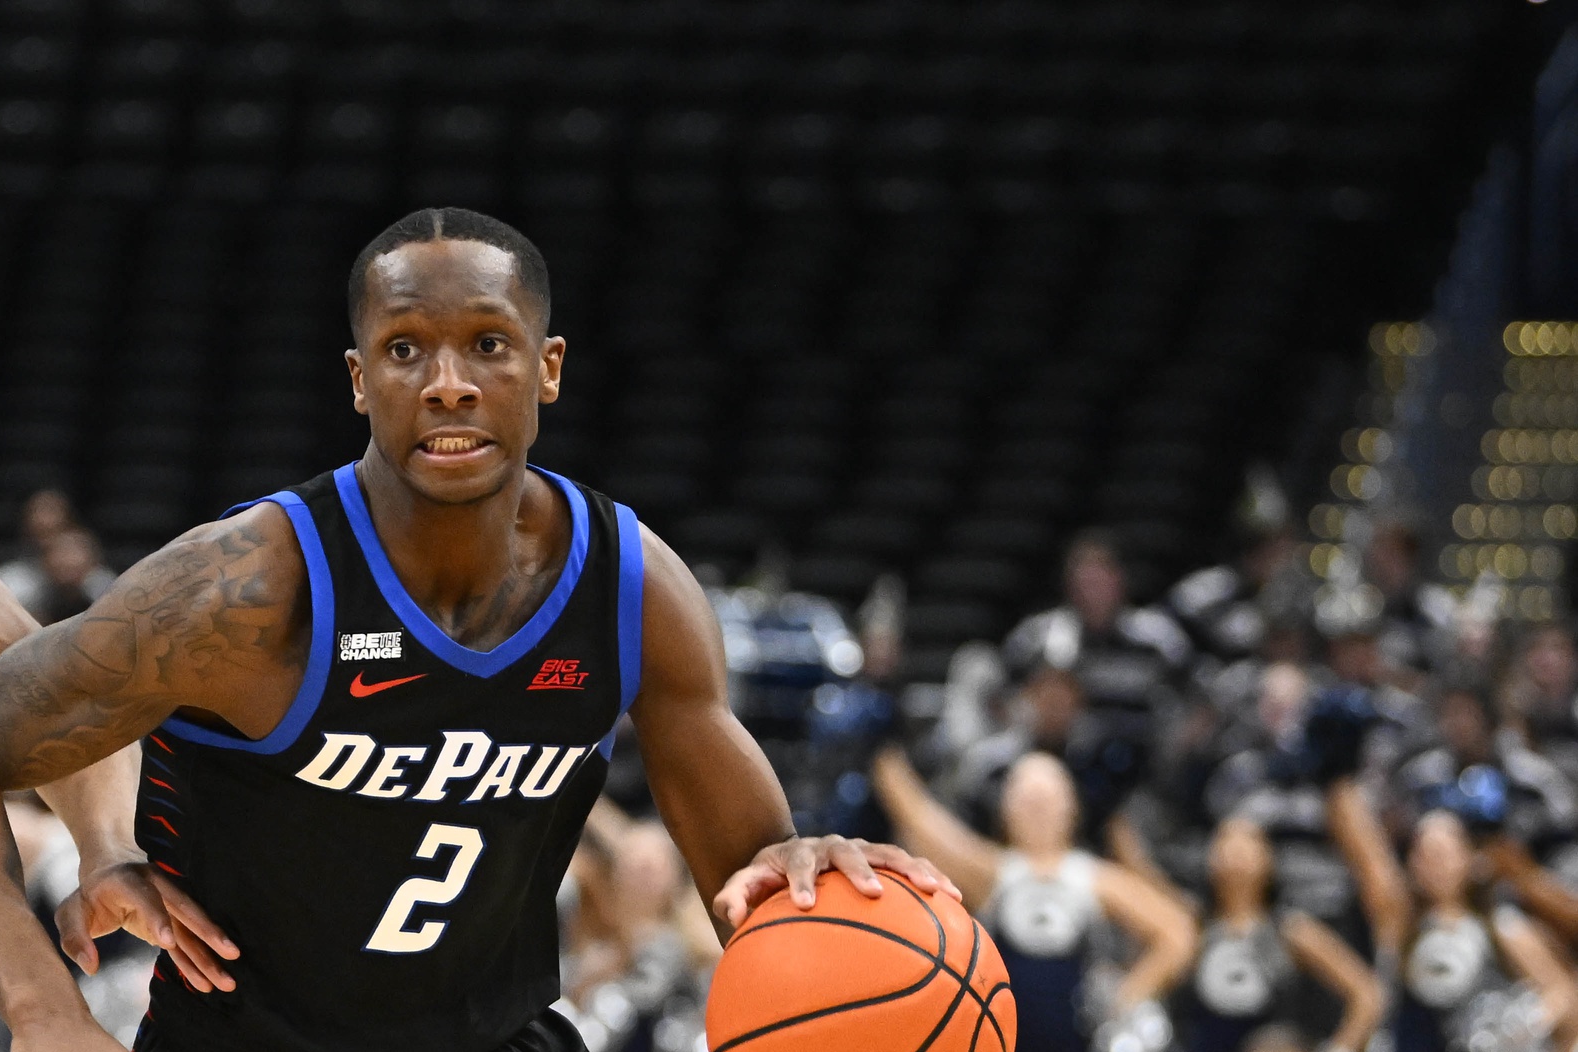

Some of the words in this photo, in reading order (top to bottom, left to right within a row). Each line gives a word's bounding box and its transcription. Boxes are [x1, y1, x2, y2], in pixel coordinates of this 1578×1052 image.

[340, 647, 402, 661] CHANGE
[539, 659, 580, 672] BIG
[532, 672, 590, 685] EAST
[294, 729, 600, 804] DEPAU
[360, 820, 487, 953] 2
